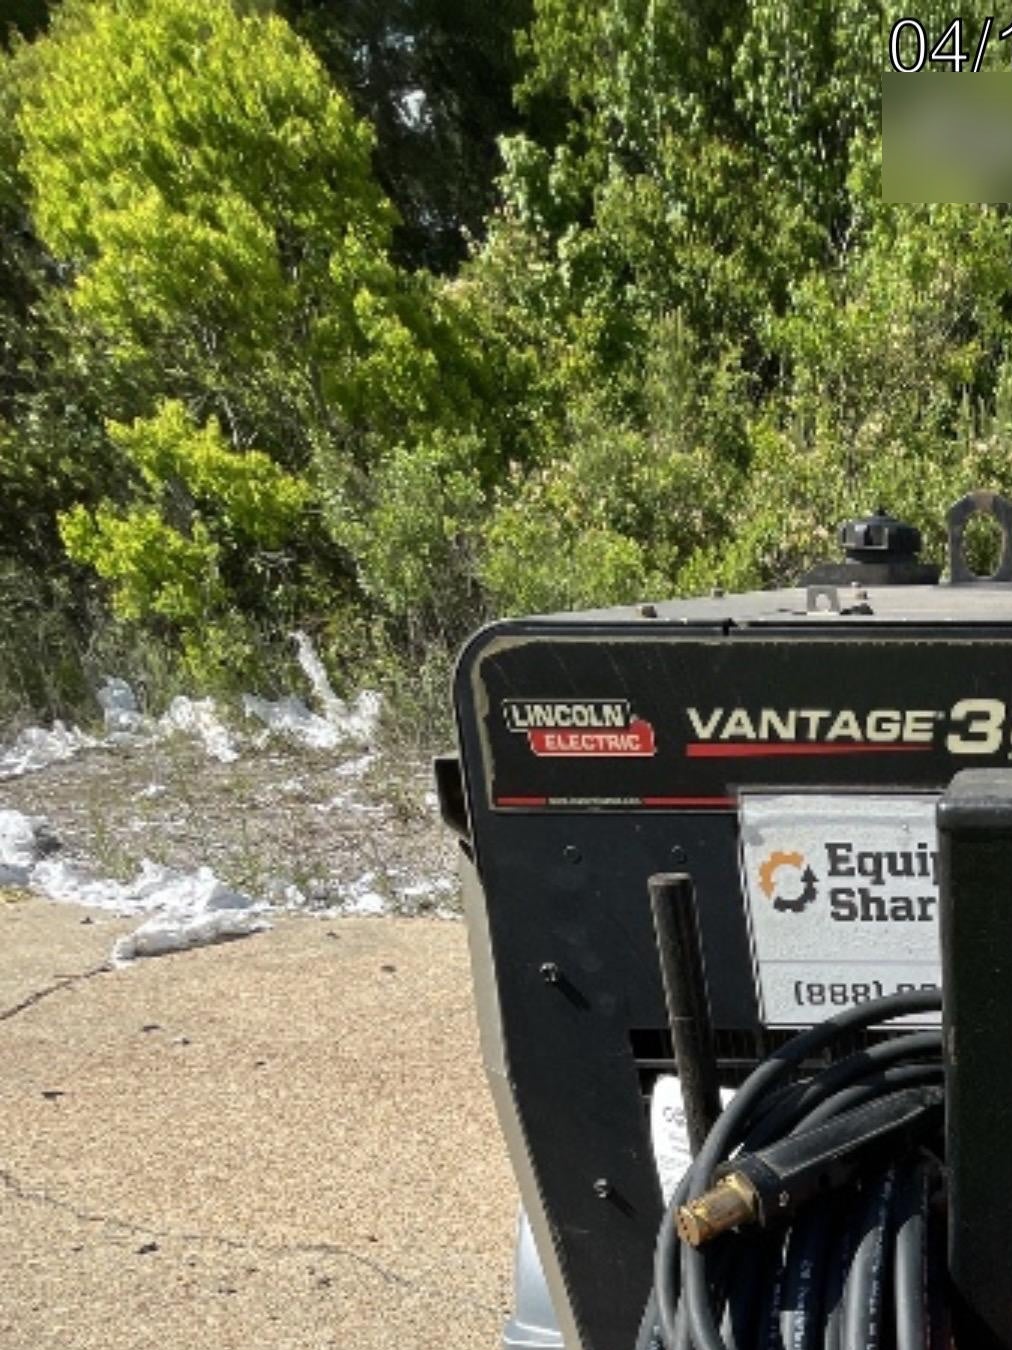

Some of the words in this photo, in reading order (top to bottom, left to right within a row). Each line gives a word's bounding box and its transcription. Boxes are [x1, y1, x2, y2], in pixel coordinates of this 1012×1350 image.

[511, 703, 625, 728] LINCOLN
[687, 707, 935, 743] VANTAGE
[543, 733, 641, 752] ELECTRIC
[825, 842, 939, 886] Equi
[830, 887, 937, 922] Shar
